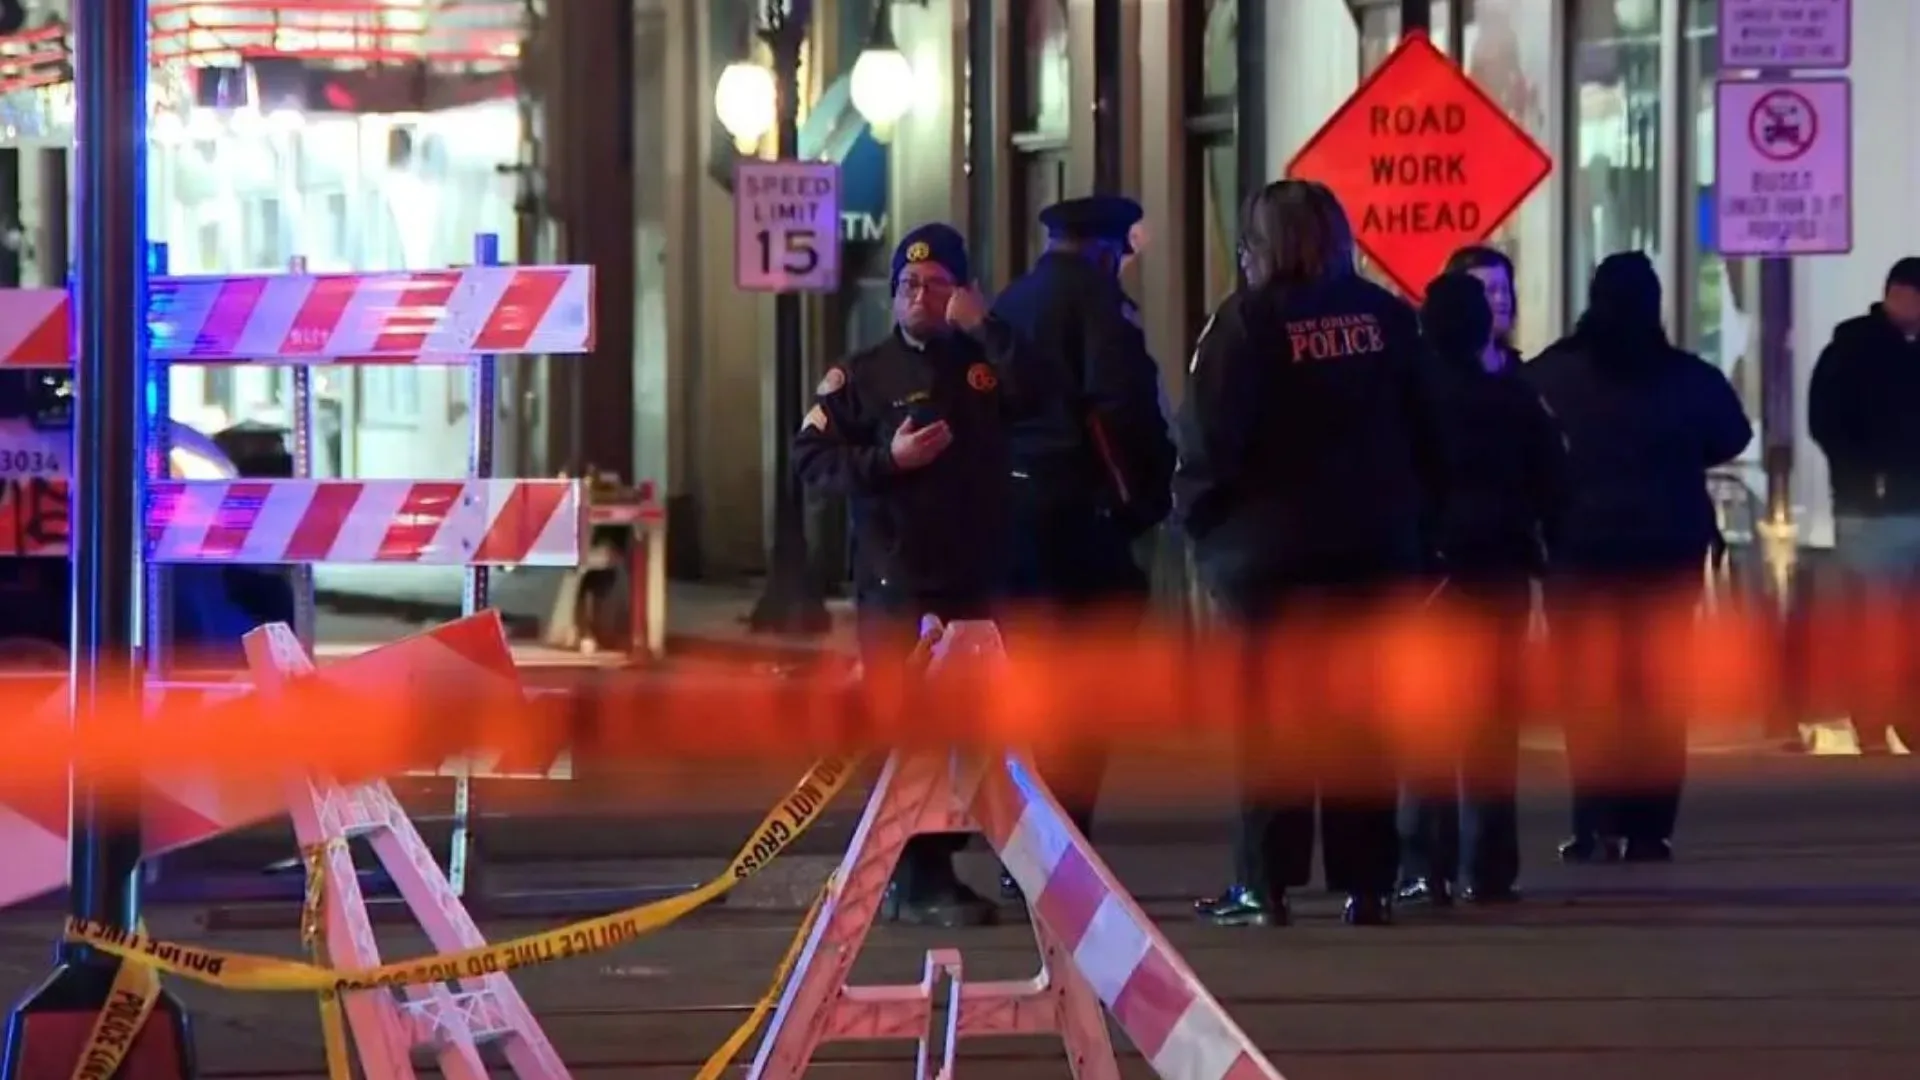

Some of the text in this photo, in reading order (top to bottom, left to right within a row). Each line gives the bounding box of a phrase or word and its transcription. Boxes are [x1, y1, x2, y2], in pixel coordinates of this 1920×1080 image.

[1369, 103, 1466, 136] ROAD
[746, 175, 831, 197] SPEED
[1370, 154, 1466, 185] WORK
[753, 202, 819, 222] LIMIT
[839, 211, 888, 241] TM
[1362, 201, 1480, 233] AHEAD
[756, 230, 819, 275] 15
[1290, 326, 1384, 362] POLICE
[783, 782, 823, 827] NOT
[734, 819, 790, 878] CROSS
[96, 990, 145, 1050] POLICE
